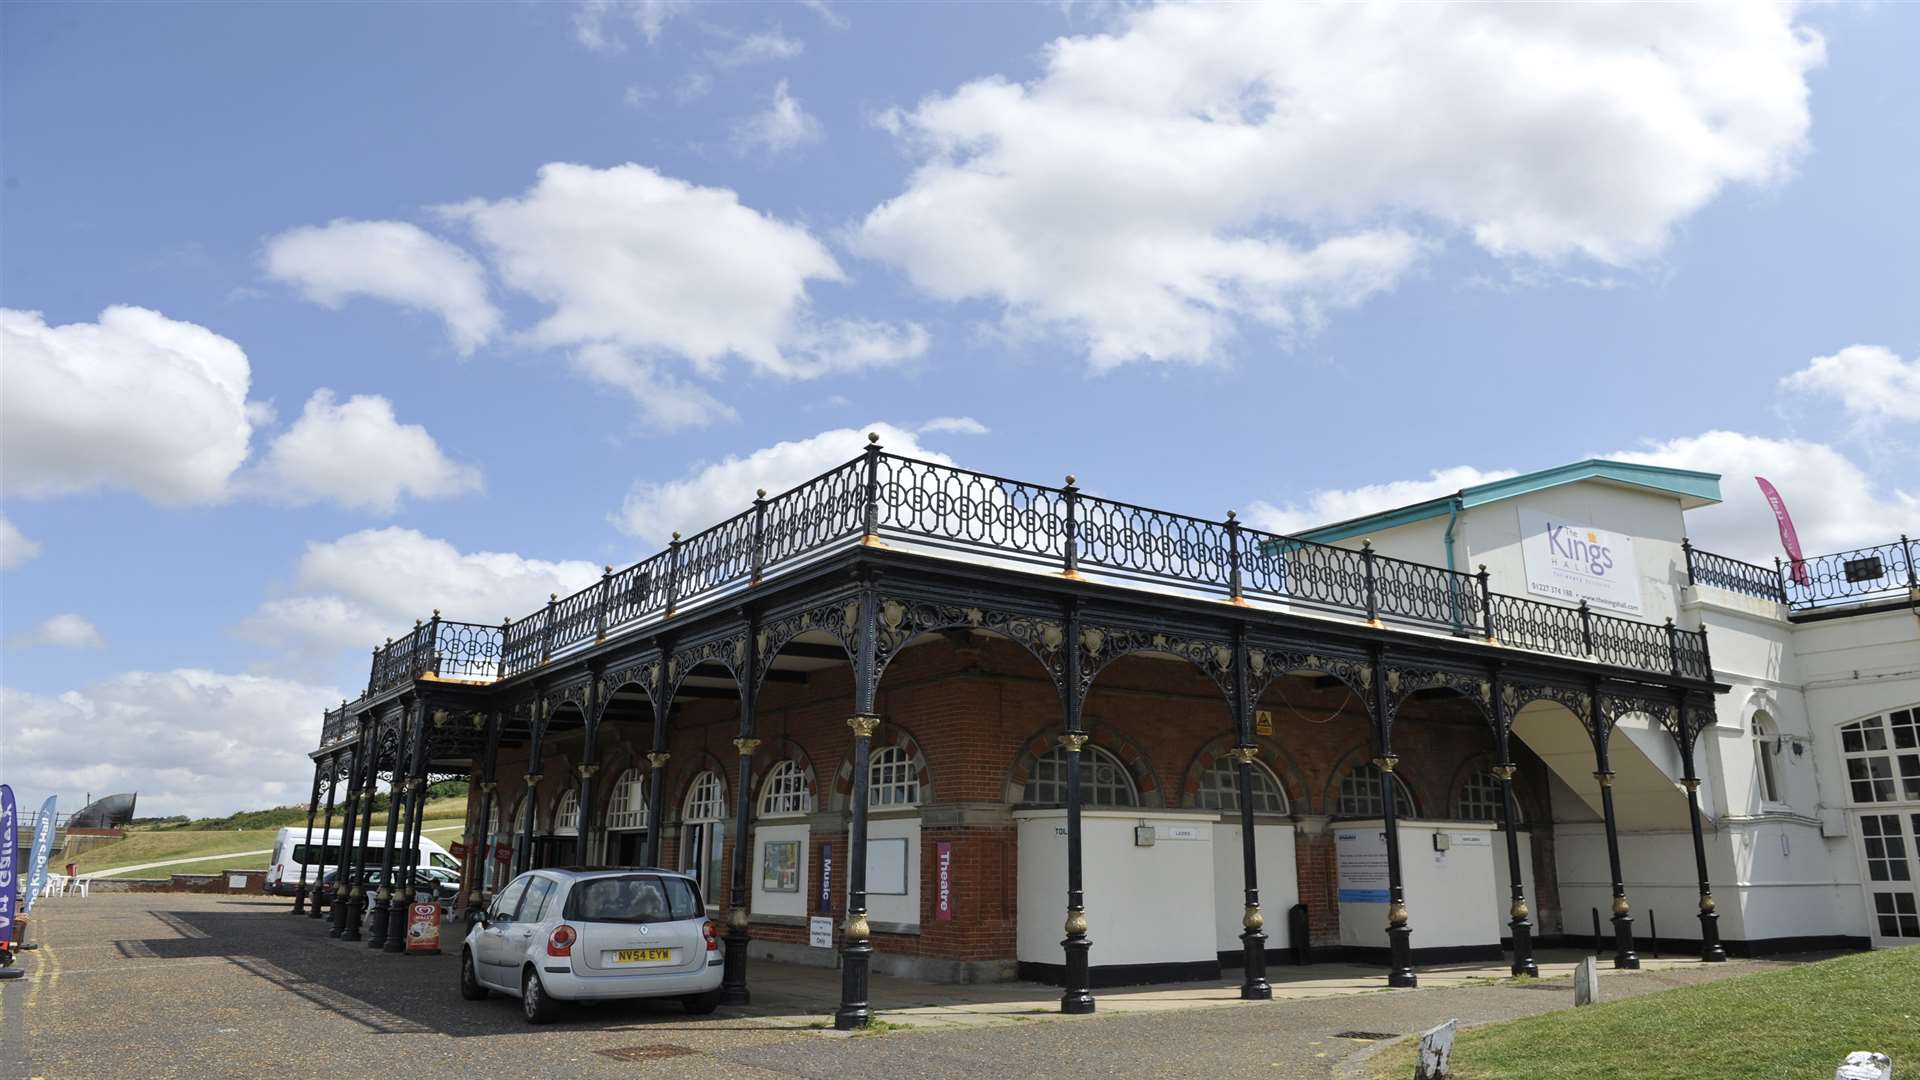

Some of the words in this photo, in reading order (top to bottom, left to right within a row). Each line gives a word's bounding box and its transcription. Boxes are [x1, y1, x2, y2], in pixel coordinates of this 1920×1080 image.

[1565, 528, 1579, 538] The
[1546, 522, 1613, 575] Kings
[1551, 559, 1590, 574] HALL
[39, 817, 49, 844] Hall
[823, 858, 832, 900] Music
[940, 851, 950, 912] Theatre
[618, 950, 646, 961] NV54
